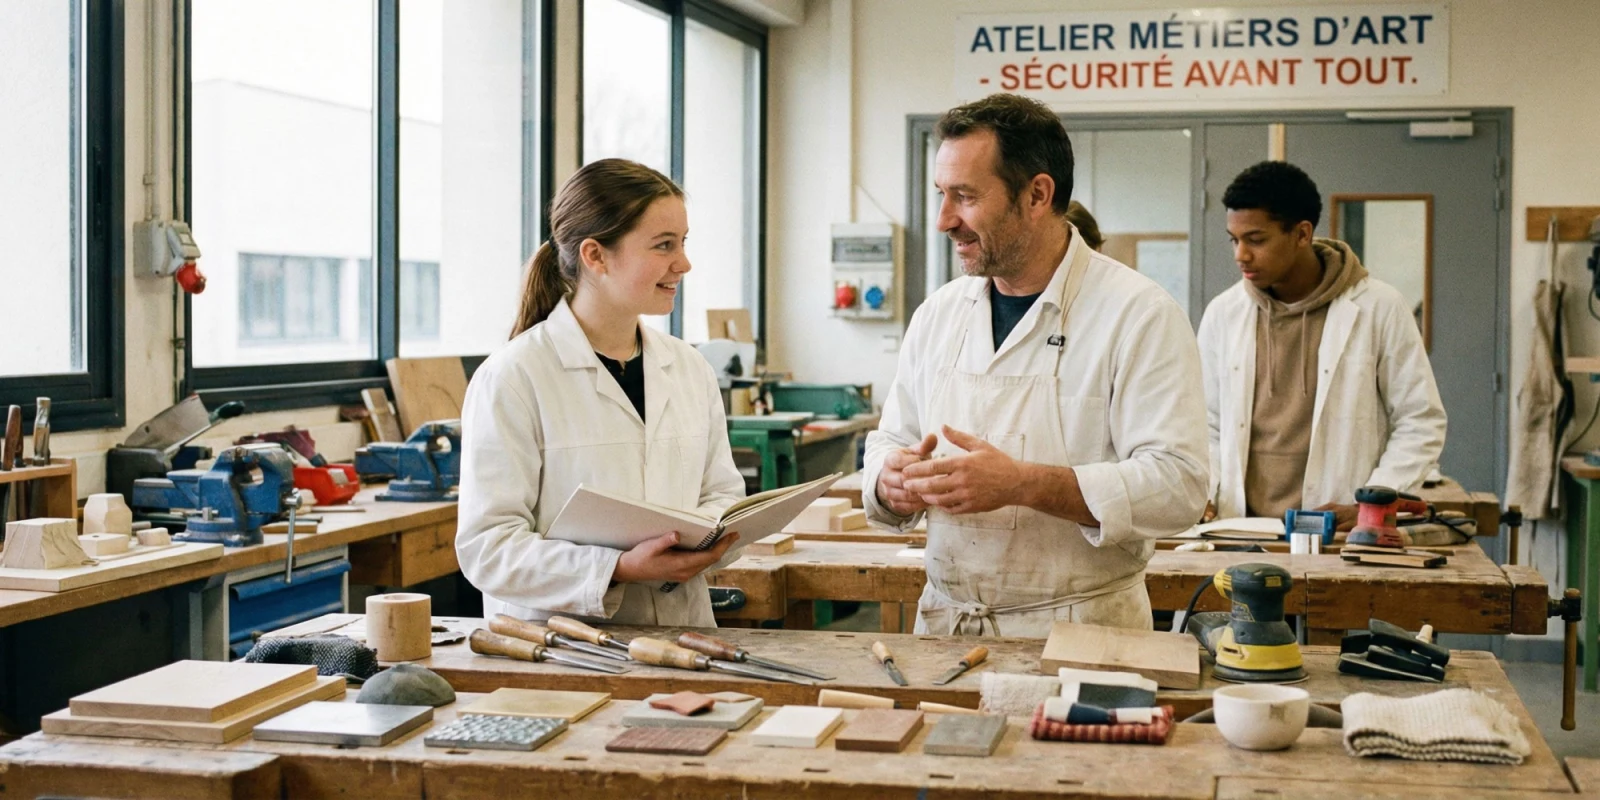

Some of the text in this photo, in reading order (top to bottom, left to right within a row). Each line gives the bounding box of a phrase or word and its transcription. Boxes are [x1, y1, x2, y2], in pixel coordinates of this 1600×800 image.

[970, 14, 1433, 53] ATELIER MÉTIERS D’ART
[1001, 54, 1173, 91] SÉCURITÉ
[1185, 59, 1302, 87] AVANT
[1314, 56, 1418, 85] TOUT.
